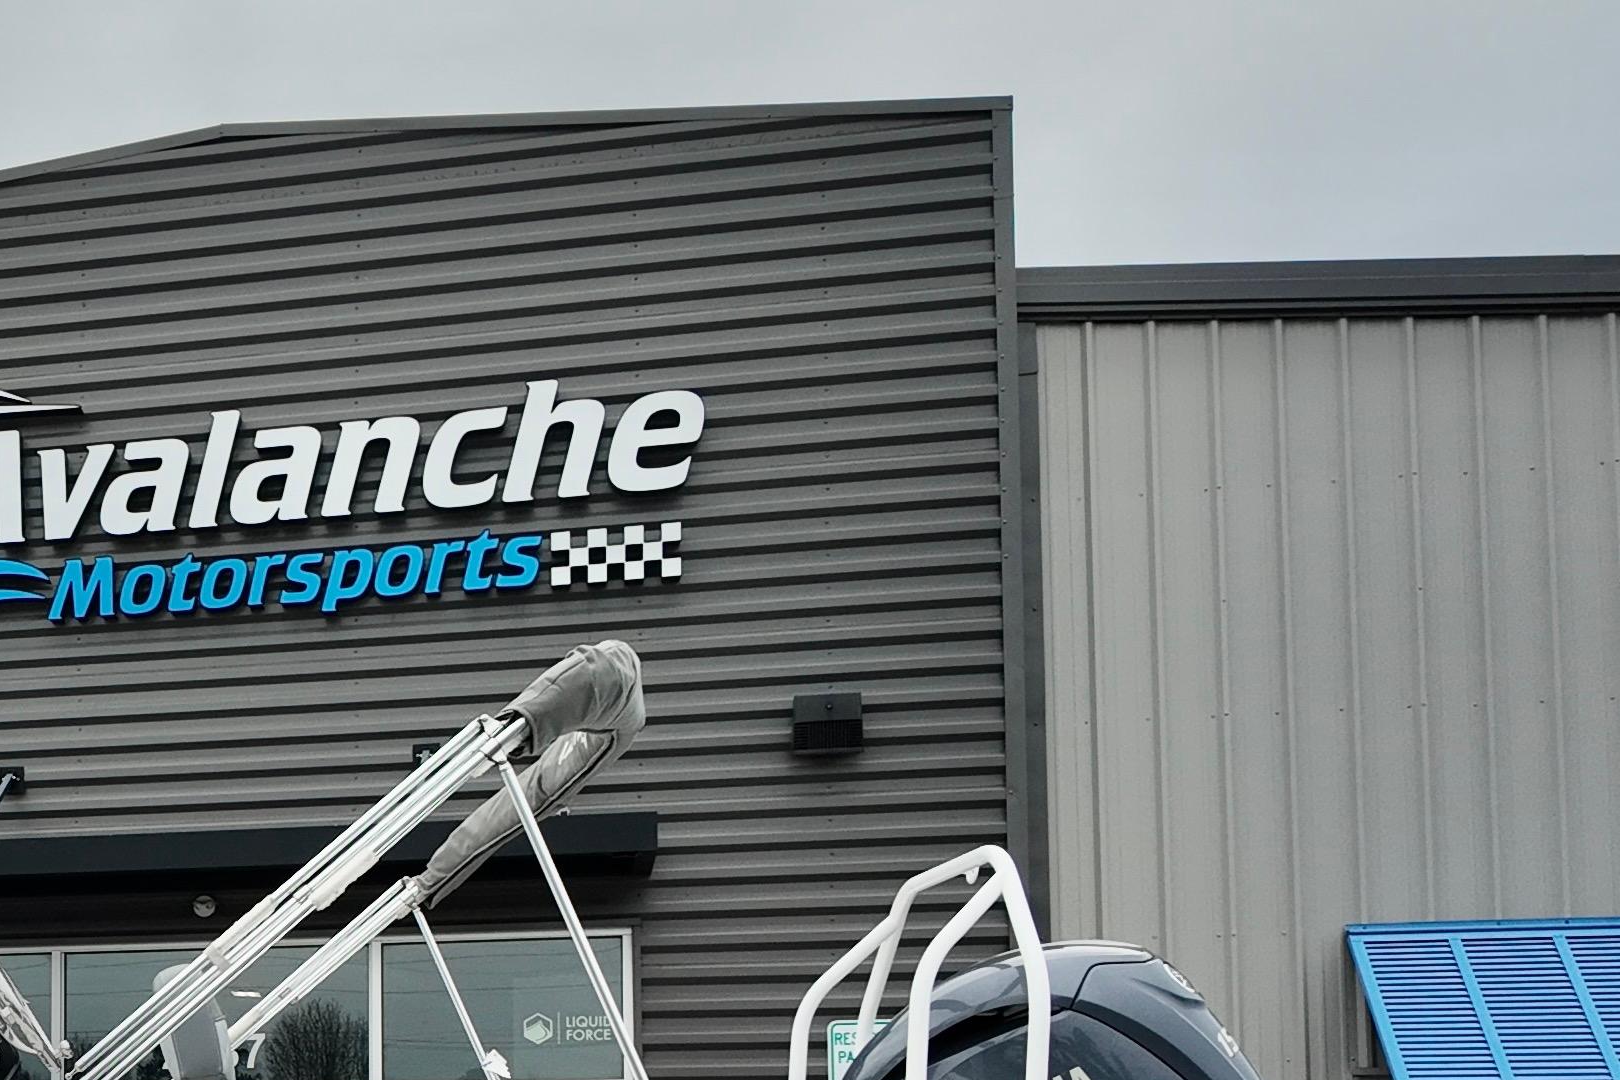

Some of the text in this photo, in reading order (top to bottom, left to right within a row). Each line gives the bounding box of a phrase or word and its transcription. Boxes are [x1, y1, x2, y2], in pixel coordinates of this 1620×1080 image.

[48, 529, 542, 621] Motorsports
[565, 1015, 611, 1028] LIQUID
[566, 1028, 612, 1041] FORCE
